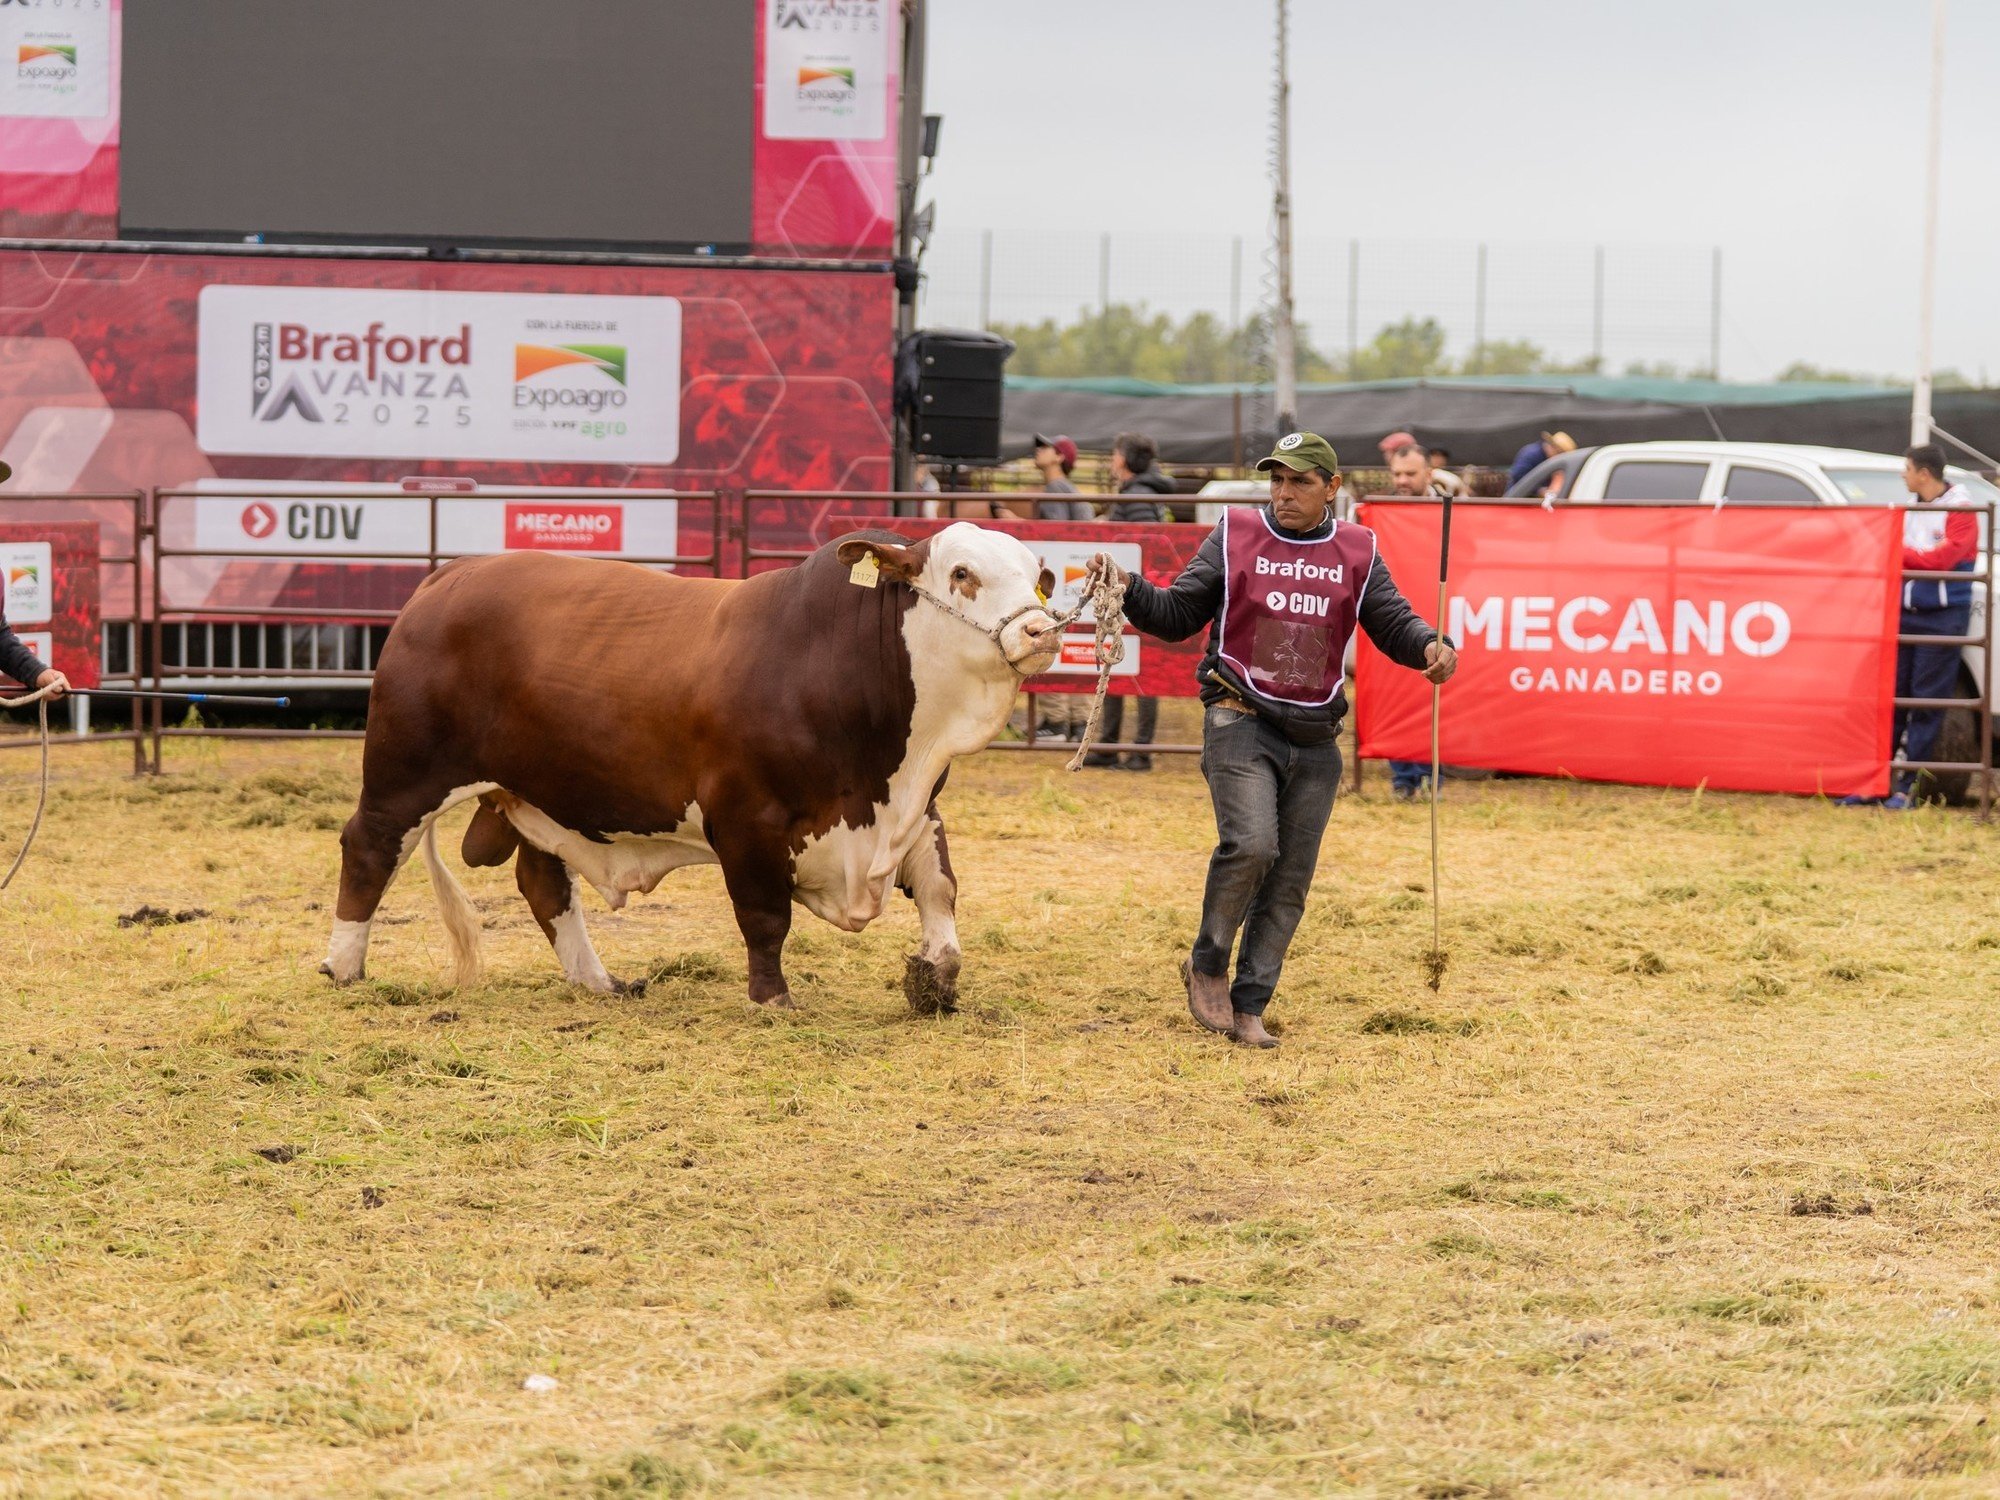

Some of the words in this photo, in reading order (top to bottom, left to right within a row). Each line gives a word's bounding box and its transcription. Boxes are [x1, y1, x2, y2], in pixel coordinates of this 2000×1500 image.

[18, 66, 77, 80] Expoagro
[254, 324, 271, 393] EXPO
[279, 322, 471, 381] Braford
[514, 385, 627, 413] Expoagro
[333, 403, 471, 425] 2025
[581, 421, 627, 438] agro
[288, 504, 363, 540] CDV
[516, 513, 612, 533] MECANO
[1255, 556, 1343, 584] Braford
[1289, 592, 1330, 617] CDV
[1449, 596, 1792, 658] MECANO
[1509, 667, 1723, 696] GANADERO
